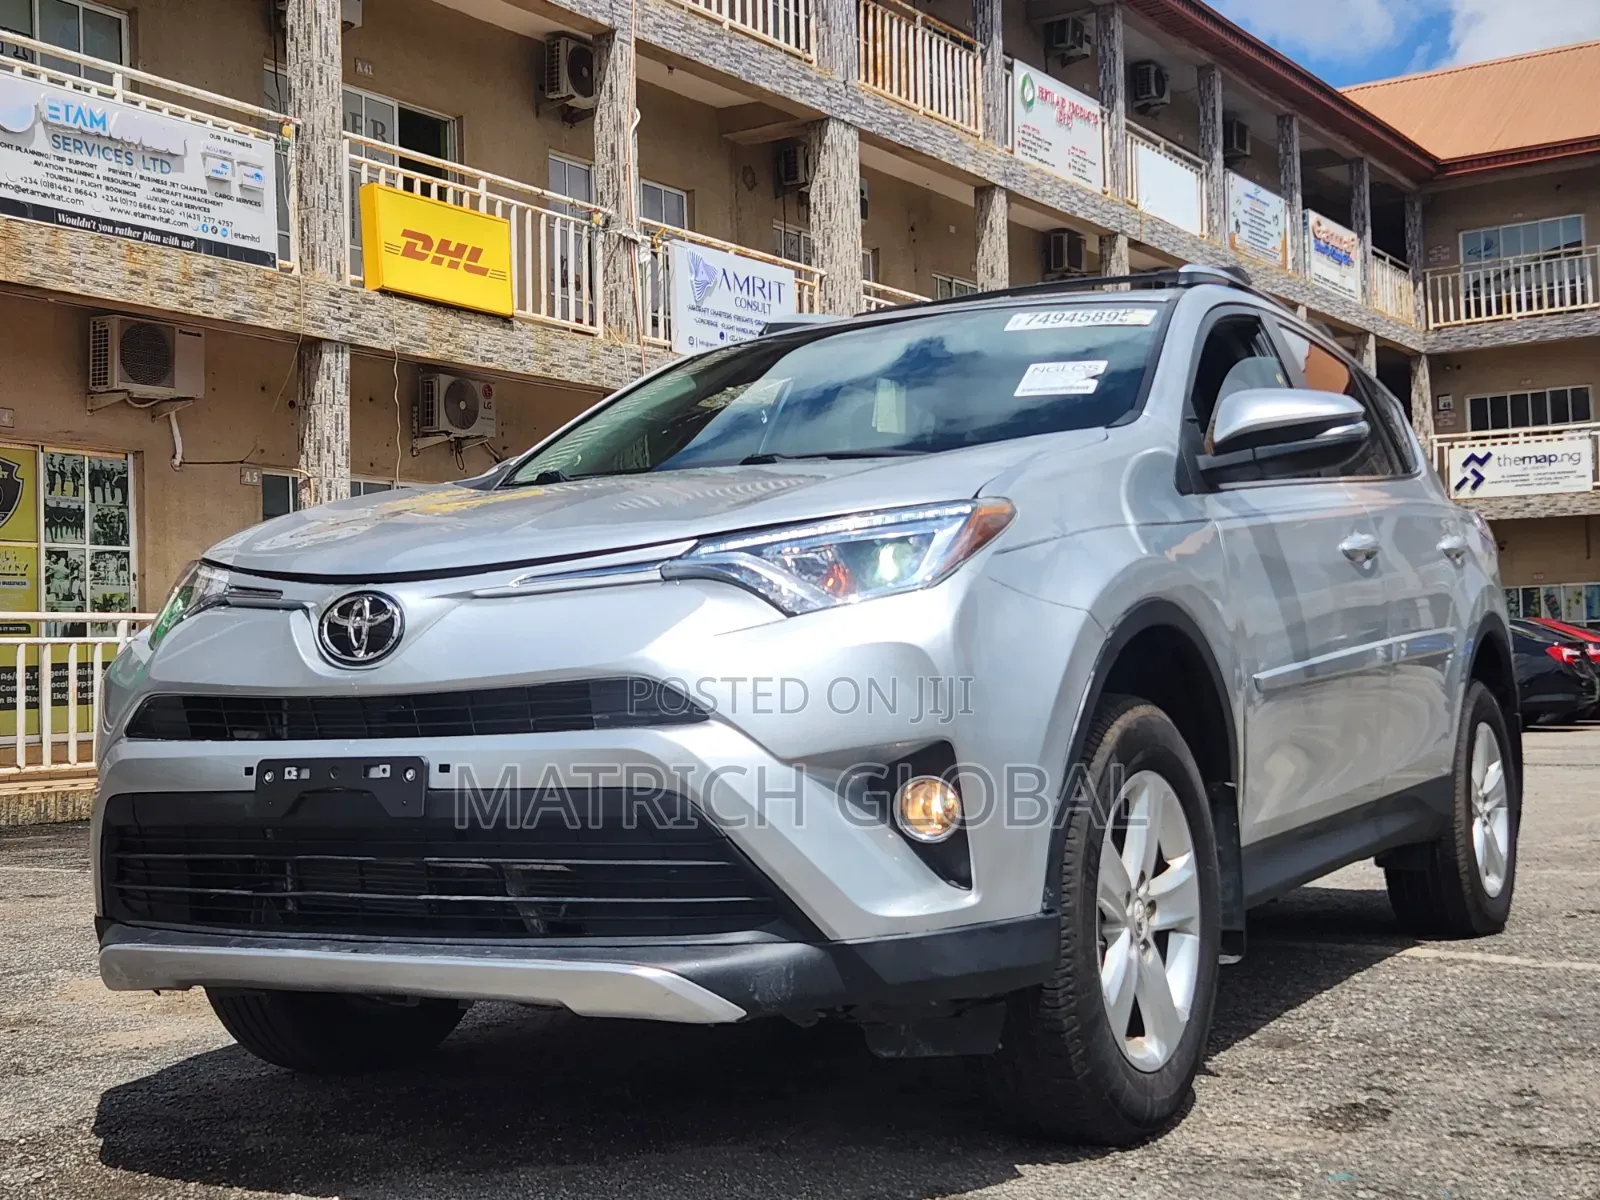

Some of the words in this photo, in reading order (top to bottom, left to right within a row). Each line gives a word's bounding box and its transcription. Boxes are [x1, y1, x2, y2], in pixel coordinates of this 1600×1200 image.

[47, 98, 107, 131] ETAM
[51, 134, 134, 167] SERVICES
[141, 155, 172, 175] LTD
[209, 133, 221, 141] OUR
[223, 136, 253, 149] PARTNERS
[20, 176, 38, 186] +234
[101, 194, 119, 203] +234
[33, 160, 64, 172] AVIATION
[65, 167, 95, 178] TRAINING
[102, 175, 141, 189] RESOURCING
[151, 187, 182, 198] AIRCRAFT
[183, 193, 223, 208] MANAGEMENT
[45, 172, 75, 183] TOURISM
[80, 179, 103, 189] FLIGHT
[104, 185, 137, 198] BOOKINGS
[146, 194, 170, 206] LUXURY
[170, 200, 183, 209] CAR
[184, 203, 211, 214] SERVICES
[68, 158, 98, 170] SUPPORT
[107, 167, 133, 178] PRIVATE
[139, 175, 167, 186] BUSINESS
[180, 185, 208, 195] CHARTER
[214, 191, 235, 202] CARGO
[235, 197, 262, 207] SERVICES
[57, 213, 96, 229] Wouldn't
[97, 221, 114, 234] you
[114, 226, 142, 238] rather
[142, 230, 161, 242] plan
[162, 234, 180, 246] with
[181, 239, 195, 250] us?
[399, 228, 491, 277] DHL
[718, 267, 786, 305] AMRIT
[734, 296, 772, 316] CONSULT
[483, 401, 492, 410] LG
[1496, 451, 1581, 467] themap.ng
